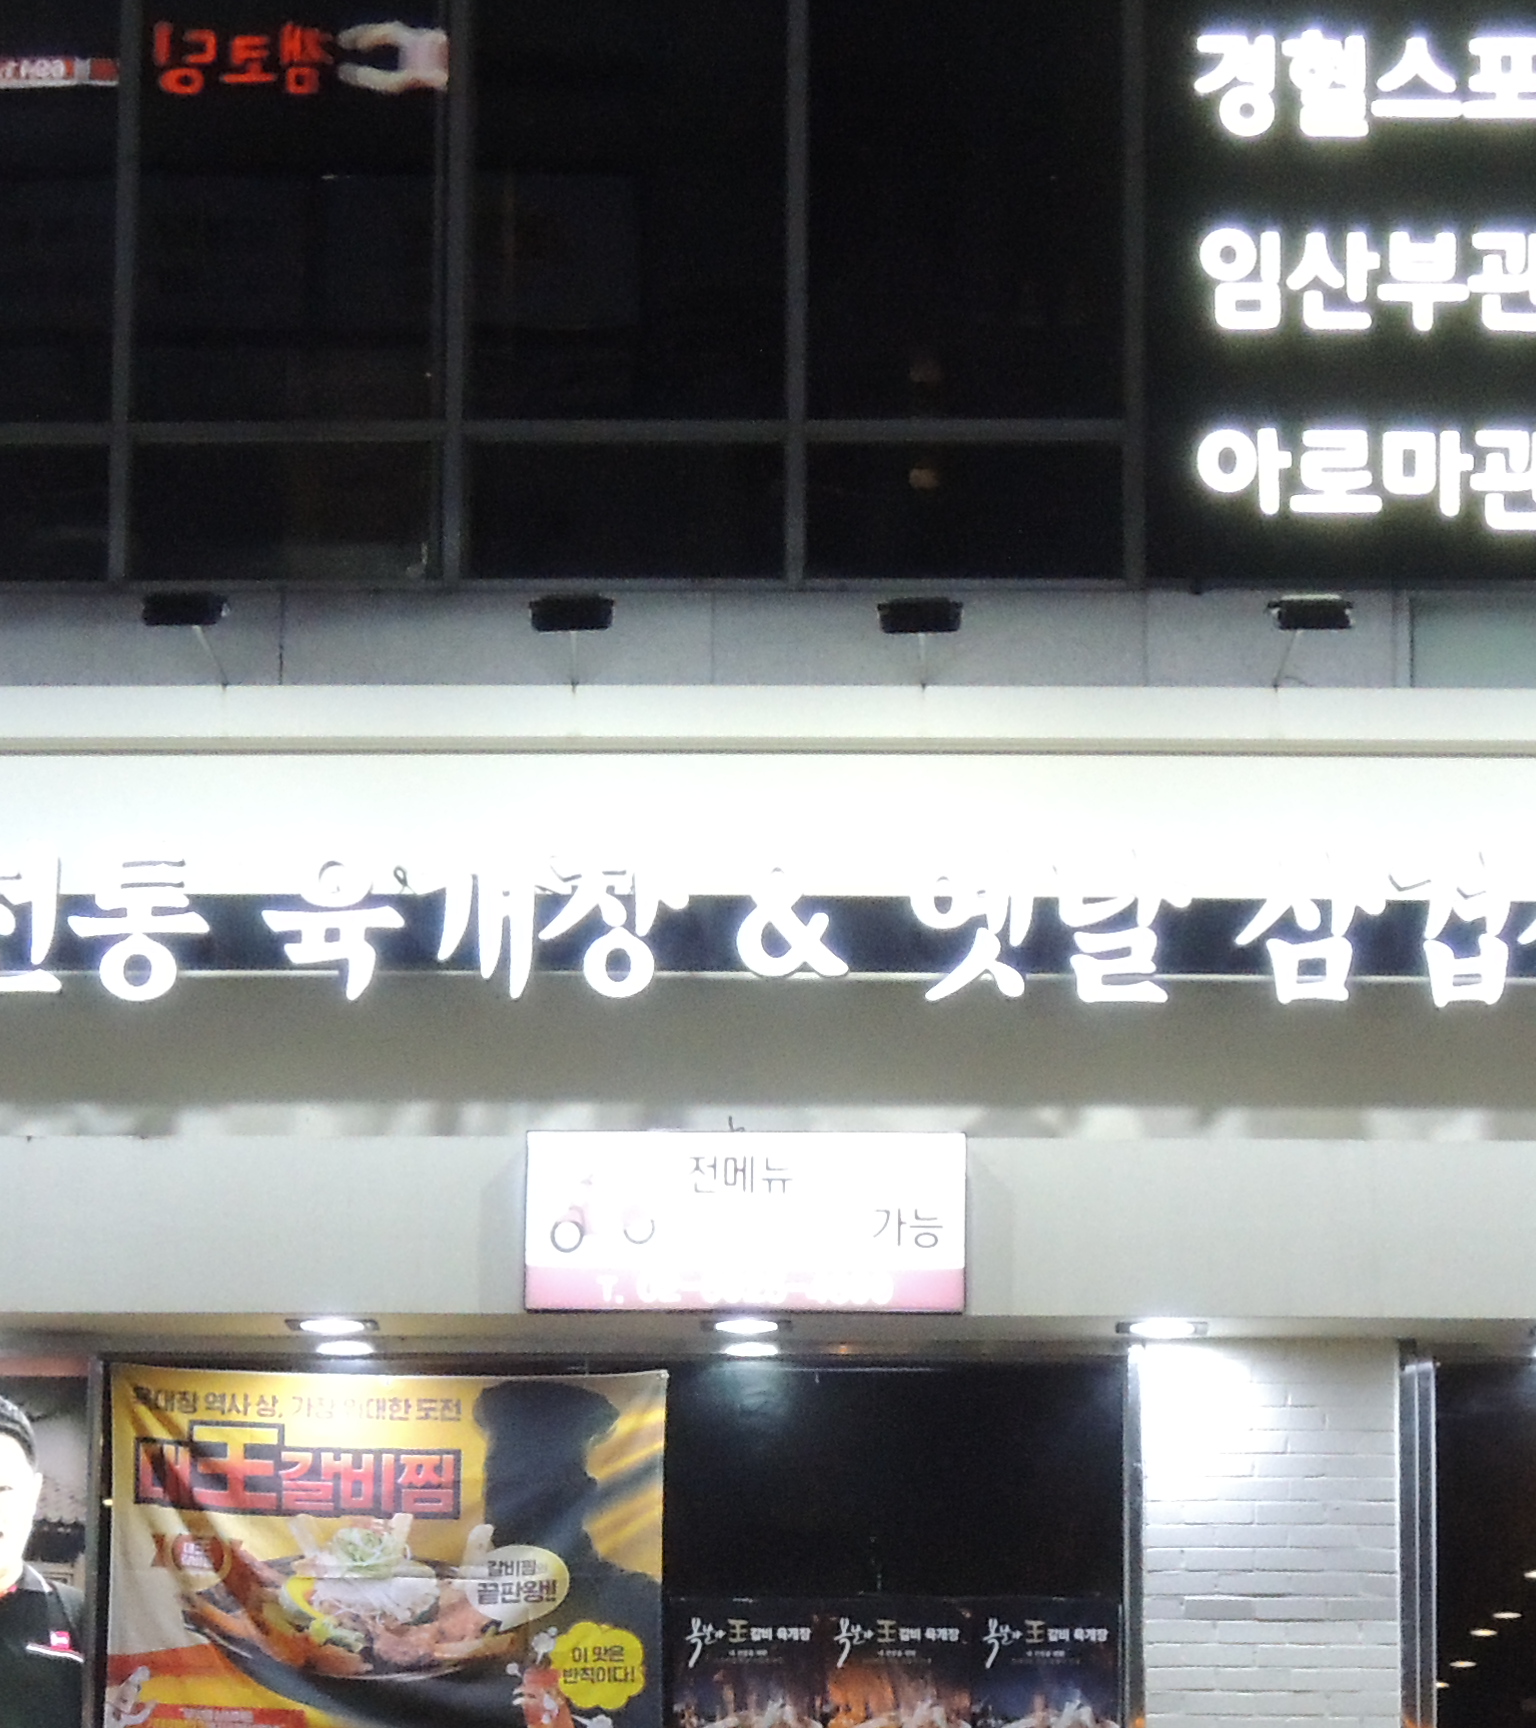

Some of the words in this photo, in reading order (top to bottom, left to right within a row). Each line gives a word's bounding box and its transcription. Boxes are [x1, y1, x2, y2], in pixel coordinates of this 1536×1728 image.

[263, 855, 693, 1002] 육개장
[737, 867, 849, 979] &
[910, 850, 1191, 1004] 옛날
[689, 1155, 794, 1195] 전메뉴
[873, 1206, 945, 1249] 가능
[205, 1391, 251, 1416] 역사
[416, 1397, 462, 1422] 도전
[572, 1647, 588, 1663] 이
[592, 1645, 625, 1663] 맛은
[563, 1665, 636, 1684] 반칙이다!
